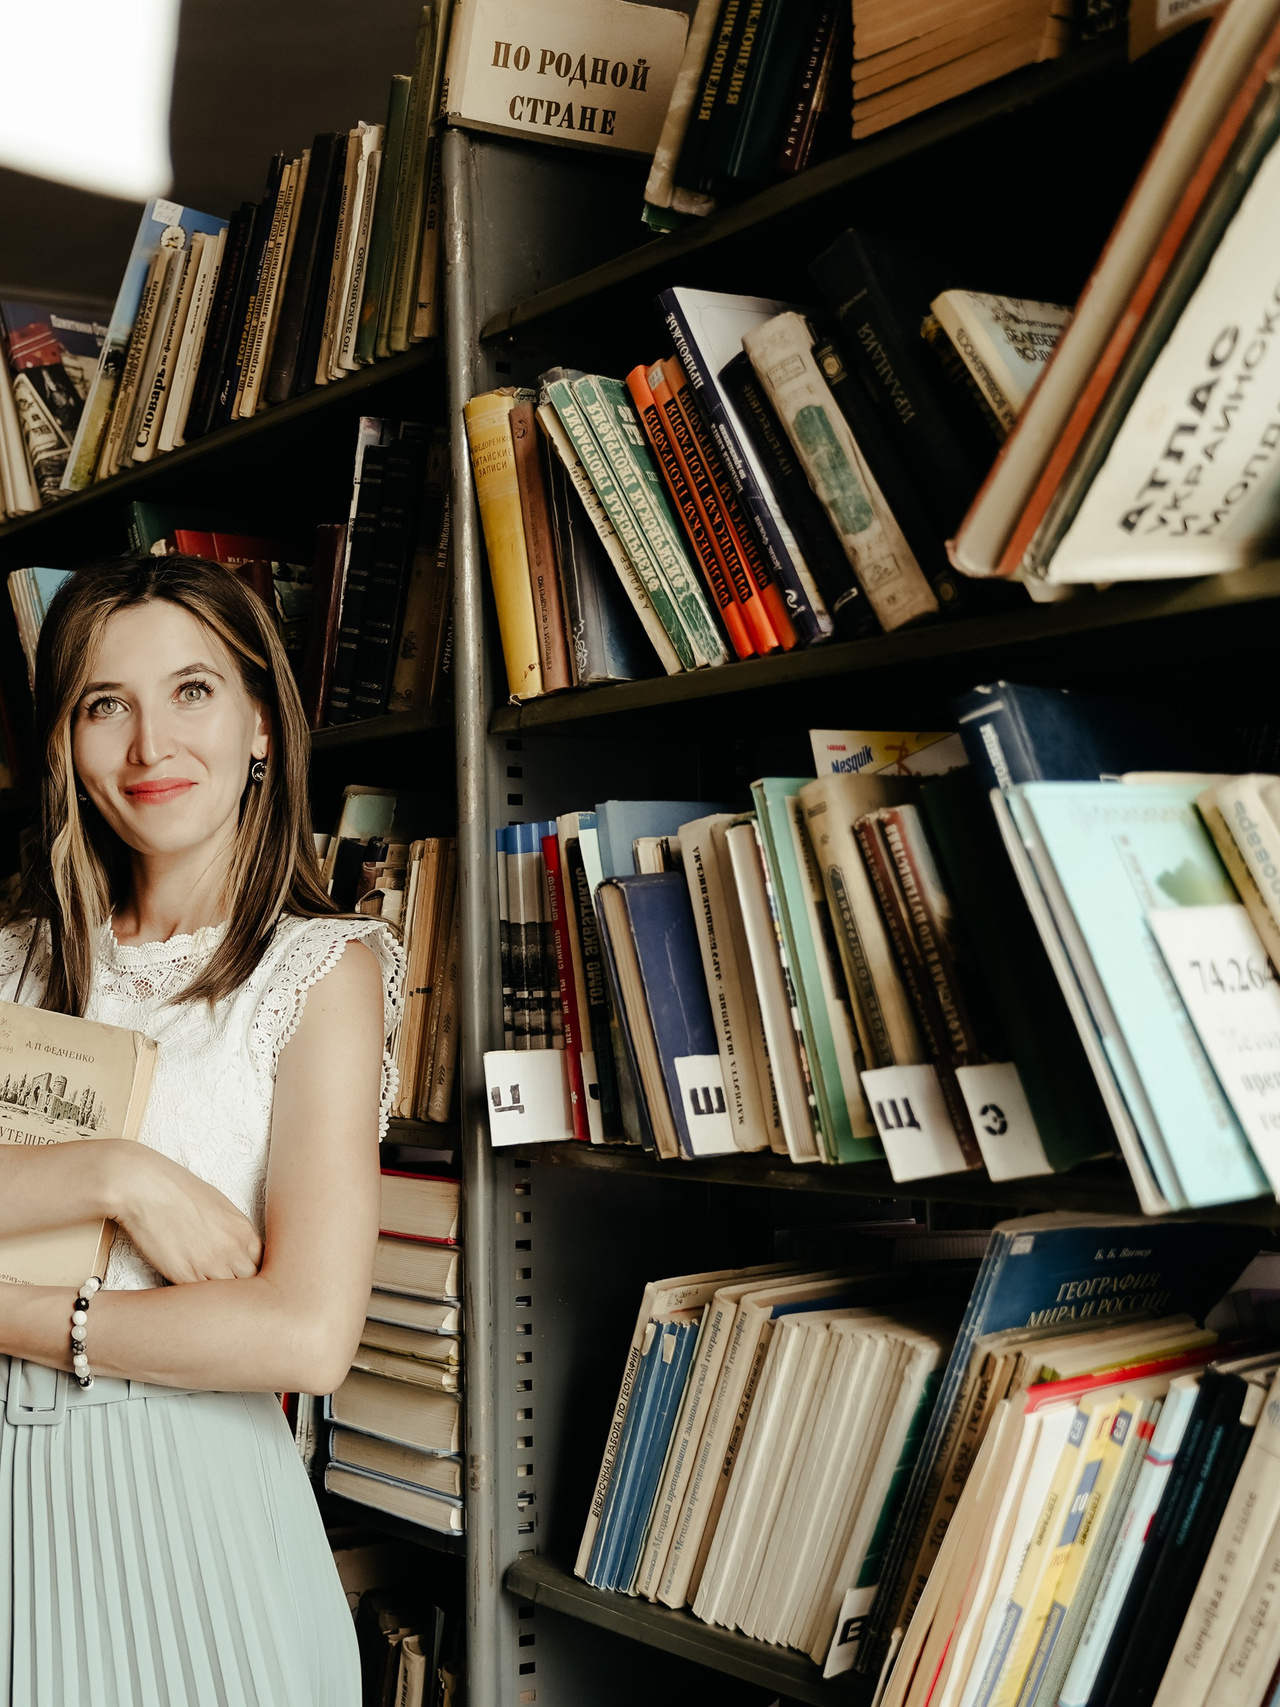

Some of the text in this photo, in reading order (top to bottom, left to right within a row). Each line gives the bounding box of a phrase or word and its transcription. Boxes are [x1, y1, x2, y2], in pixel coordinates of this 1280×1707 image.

[491, 41, 651, 93] ПО РОДНОЙ
[508, 94, 617, 137] СТРАНЕ
[783, 102, 805, 157] АЛТЫН
[247, 320, 266, 374] страницам
[259, 242, 282, 317] занимательной
[276, 184, 294, 237] географии
[340, 246, 365, 353] ПО ЗАКАВКАЗЬЮ
[137, 280, 159, 345] ГЕОГРАФИЯ
[235, 295, 257, 366] ГЕОГРАФИЯ
[662, 311, 705, 389] ПРИВОЛЖЬЕ
[854, 321, 916, 423] ИРЛАНДИЯ
[134, 366, 168, 448] Словарь
[158, 353, 169, 366] по
[478, 461, 508, 478] ЗАПИСИ
[561, 403, 612, 490] ГЕОГРАФИЯ
[587, 400, 637, 486] ГЕОГРАФИЯ
[643, 410, 731, 605] ФИЗИЧЕСКАЯ ГЕОГРАФИЯ
[663, 402, 752, 600] ФИЗИЧЕСКАЯ ГЕОГРАФИЯ
[677, 389, 771, 587] ФИЗИЧЕСКАЯ ГЕОГРАФИЯ
[604, 491, 662, 591] ФИЗИЧЕСКАЯ
[626, 483, 687, 589] ФИЗИЧЕСКАЯ
[831, 744, 874, 774] Nesquik
[884, 823, 926, 924] ПУТЕШЕСТВИЯ
[553, 928, 564, 969] СТАНЕШЬ
[835, 887, 871, 985] ТОПОГРАФИИ
[558, 978, 566, 991] ТЫ
[560, 999, 569, 1014] ЖЕ
[585, 960, 605, 1005] ГОМО
[44, 1046, 95, 1064] ФЕДЧЕНКО
[491, 1083, 525, 1114] Ц
[689, 1086, 727, 1115] Ш
[728, 1060, 746, 1124] МАРИЭТТА
[876, 1096, 922, 1132] Щ
[980, 1103, 1008, 1137] Э
[1026, 1292, 1171, 1328] МИРА И РОССИИ
[1056, 1272, 1162, 1303] ГЕОГРАФИЯ
[591, 1346, 640, 1518] ВНЕУРОЧНАЯ РАБОТА ПО ГЕОГРАФИИ
[653, 1310, 723, 1549] Методика преподавания экономической географии
[1068, 1418, 1084, 1440] ЕГЭ
[1111, 1416, 1127, 1438] ЕГЭ
[673, 1506, 693, 1552] Методика
[686, 1440, 711, 1505] преподавания
[1181, 1586, 1223, 1667] География
